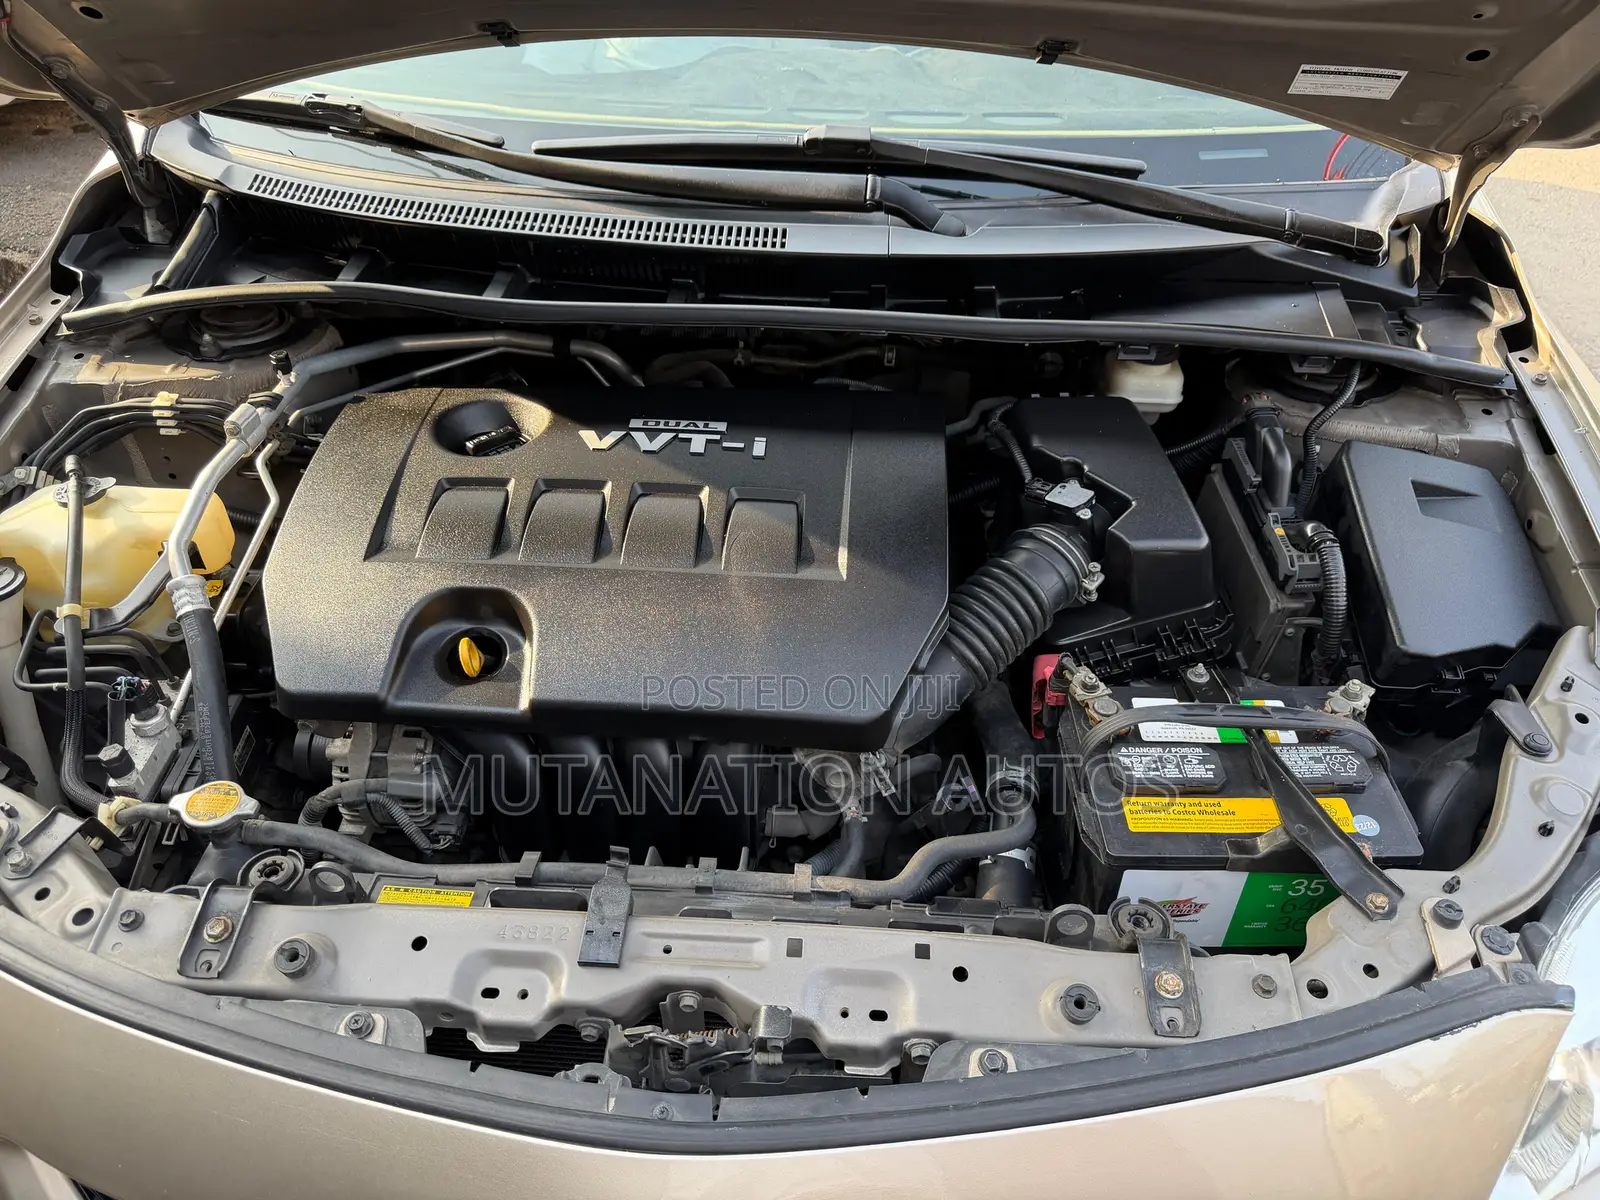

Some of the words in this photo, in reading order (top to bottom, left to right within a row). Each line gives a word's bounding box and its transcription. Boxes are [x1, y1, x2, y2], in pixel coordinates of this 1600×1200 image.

[641, 420, 719, 430] DUAL
[578, 429, 767, 459] VVT-i
[1153, 801, 1187, 810] warranty
[408, 888, 435, 896] CAUTION
[439, 890, 472, 898] ATTENTION
[1287, 879, 1328, 897] 35
[497, 924, 571, 942] 43822
